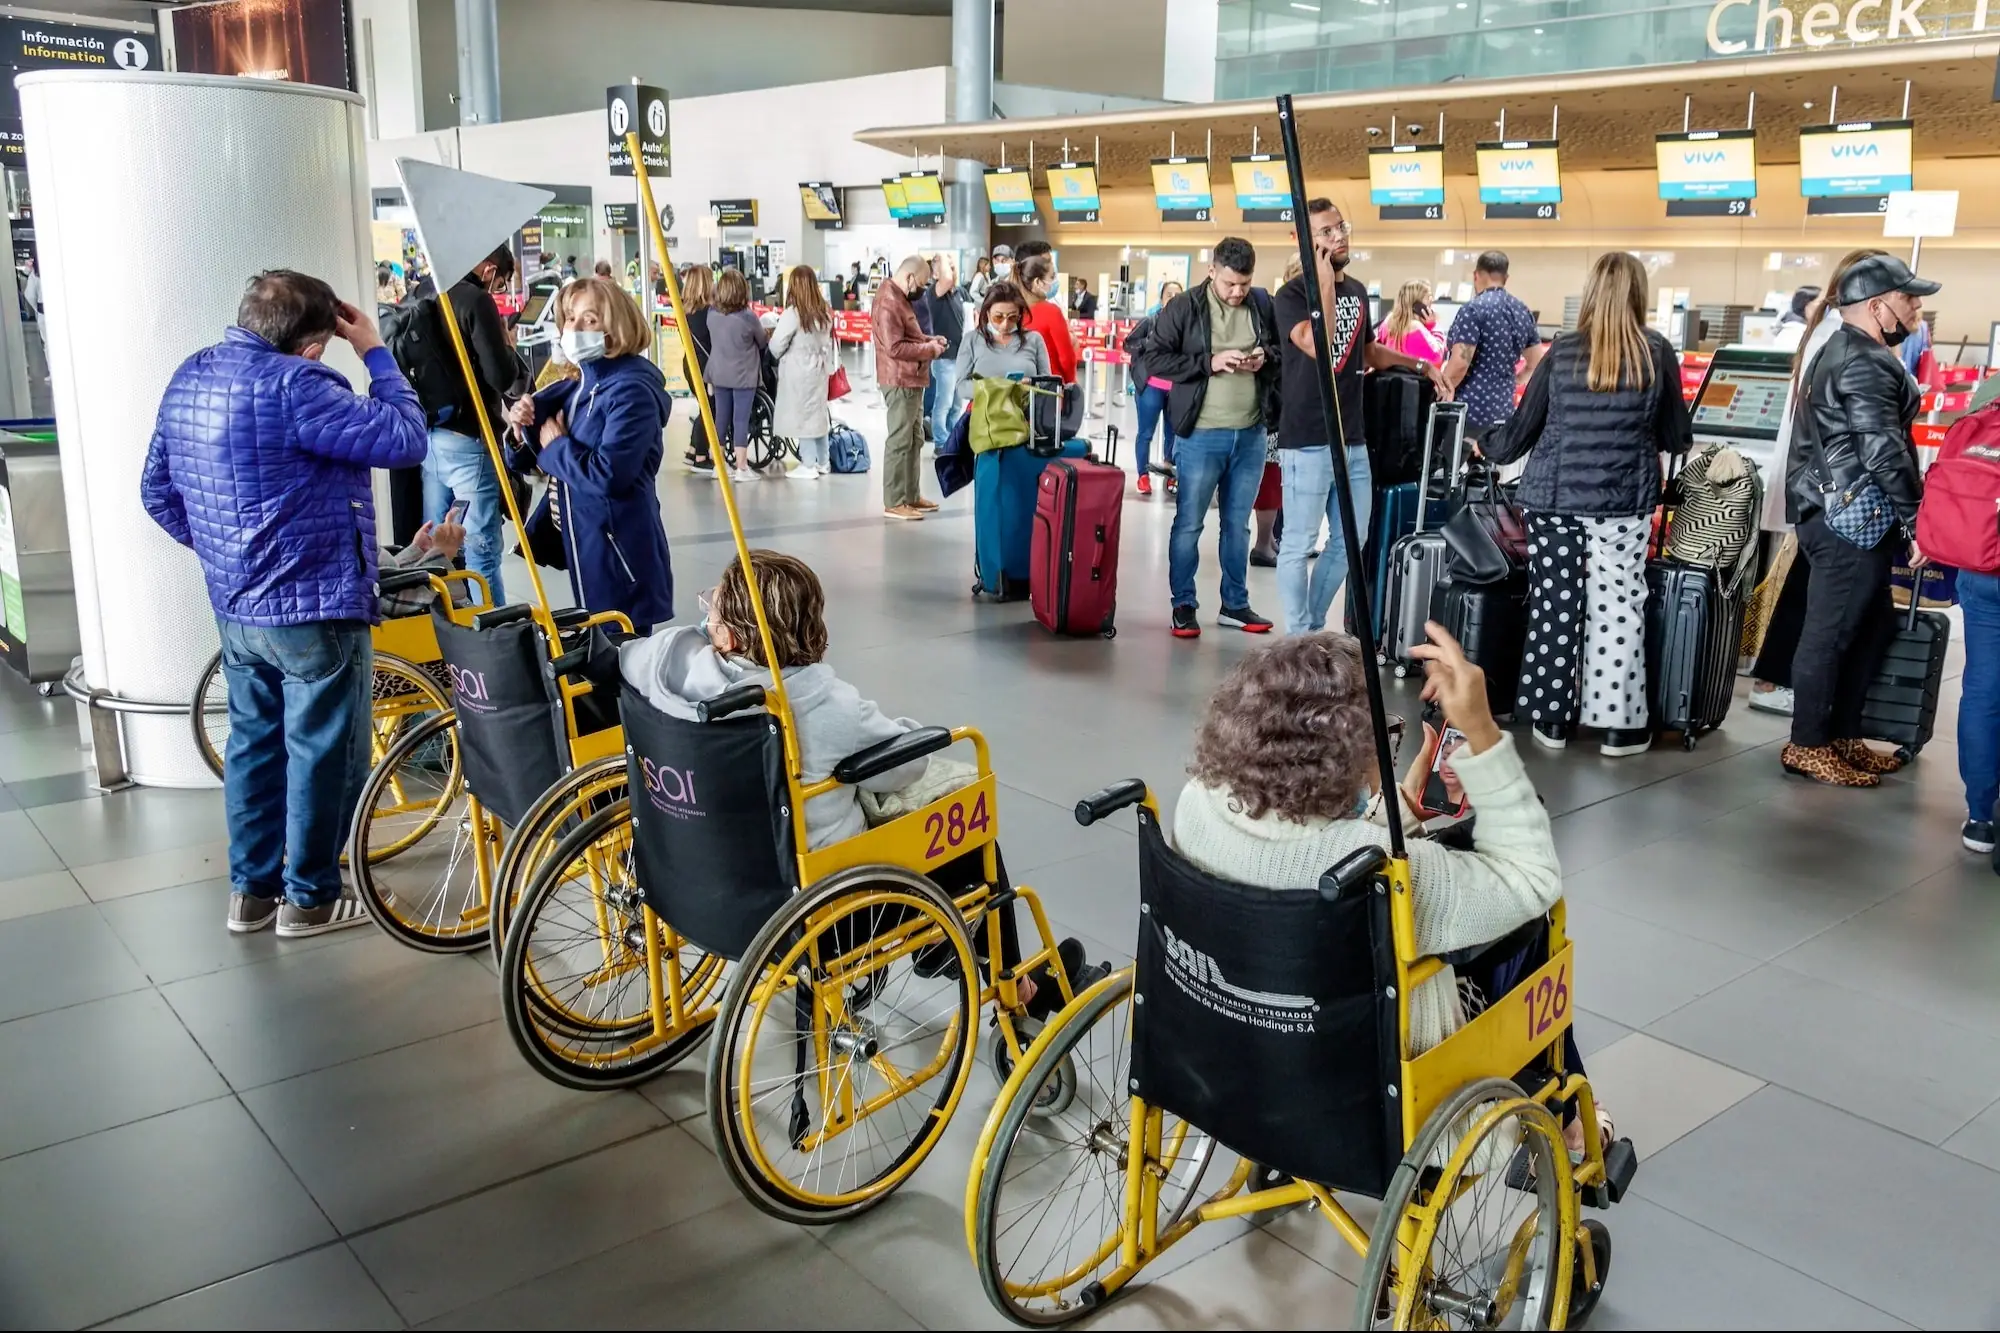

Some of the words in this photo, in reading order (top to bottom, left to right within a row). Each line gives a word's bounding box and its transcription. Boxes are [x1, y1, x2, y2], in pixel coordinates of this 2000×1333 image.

[1706, 0, 1927, 54] Check
[21, 30, 105, 50] Información
[23, 45, 106, 64] Information
[1682, 150, 1725, 163] VIVA
[1831, 143, 1878, 158] VIVA
[1389, 162, 1421, 174] VIVA
[1499, 160, 1534, 171] VIVA
[1425, 206, 1439, 218] 61
[1537, 205, 1552, 217] 60
[1728, 201, 1746, 214] 59
[1021, 213, 1031, 223] 65
[1086, 211, 1095, 221] 64
[1196, 210, 1207, 220] 63
[1280, 210, 1292, 221] 62
[925, 791, 990, 859] 284
[1174, 977, 1201, 1003] empresa
[1202, 997, 1212, 1008] de
[1213, 1003, 1247, 1023] Avianca
[1249, 1015, 1294, 1033] Holdings
[1297, 1023, 1316, 1033] S.A
[1190, 979, 1252, 1012] AEROPORTUARIOS
[1255, 1007, 1313, 1020] INTEGRADOS
[1524, 963, 1568, 1042] 126
